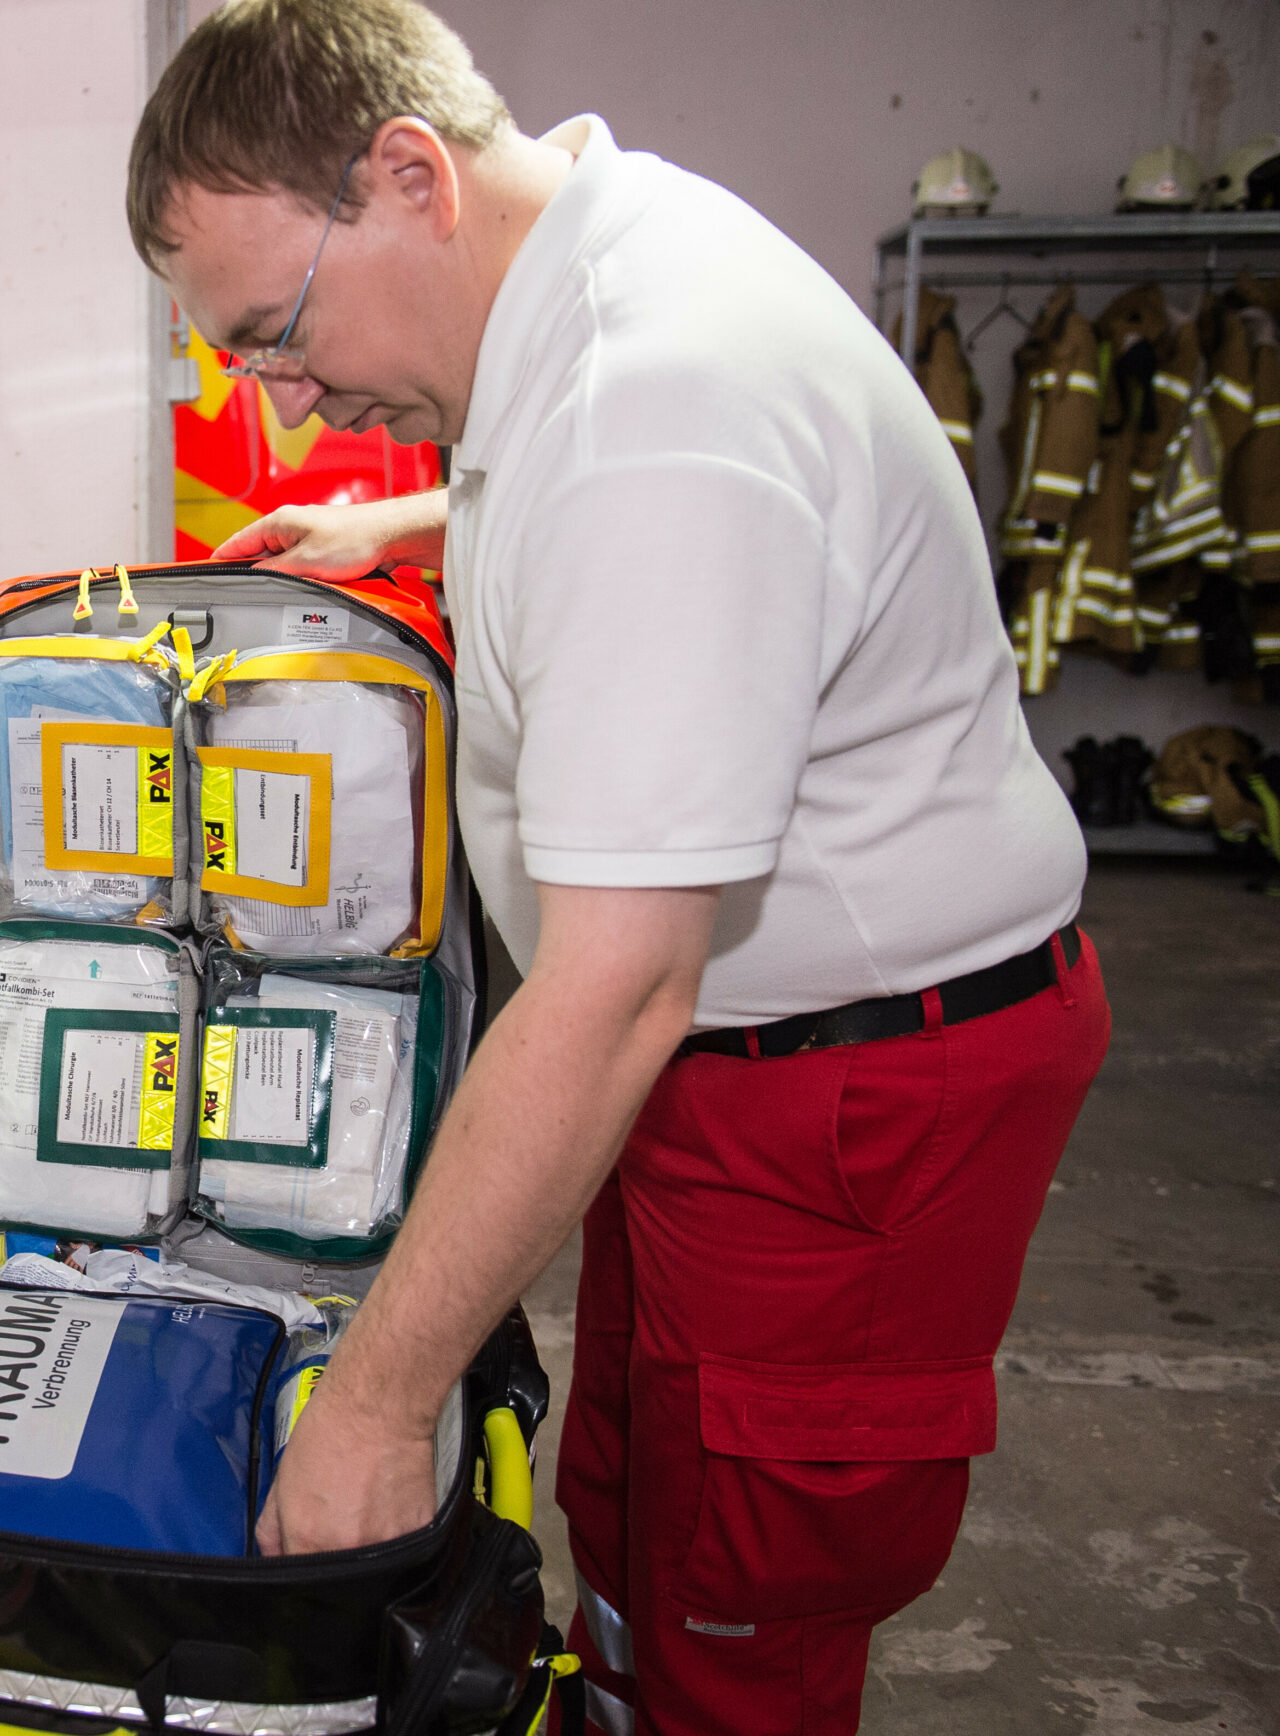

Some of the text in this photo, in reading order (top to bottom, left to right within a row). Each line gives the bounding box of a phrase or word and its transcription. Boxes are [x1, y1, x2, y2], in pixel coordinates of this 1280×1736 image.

[302, 612, 328, 624] PAX
[146, 752, 170, 803] PAX
[204, 821, 228, 872] PAX
[290, 834, 299, 870] Entbindung
[64, 1052, 76, 1120] Modultasche Chirurgie
[151, 1039, 176, 1091] PAX
[204, 1090, 219, 1123] PAX
[32, 1318, 92, 1410] Verbrennung
